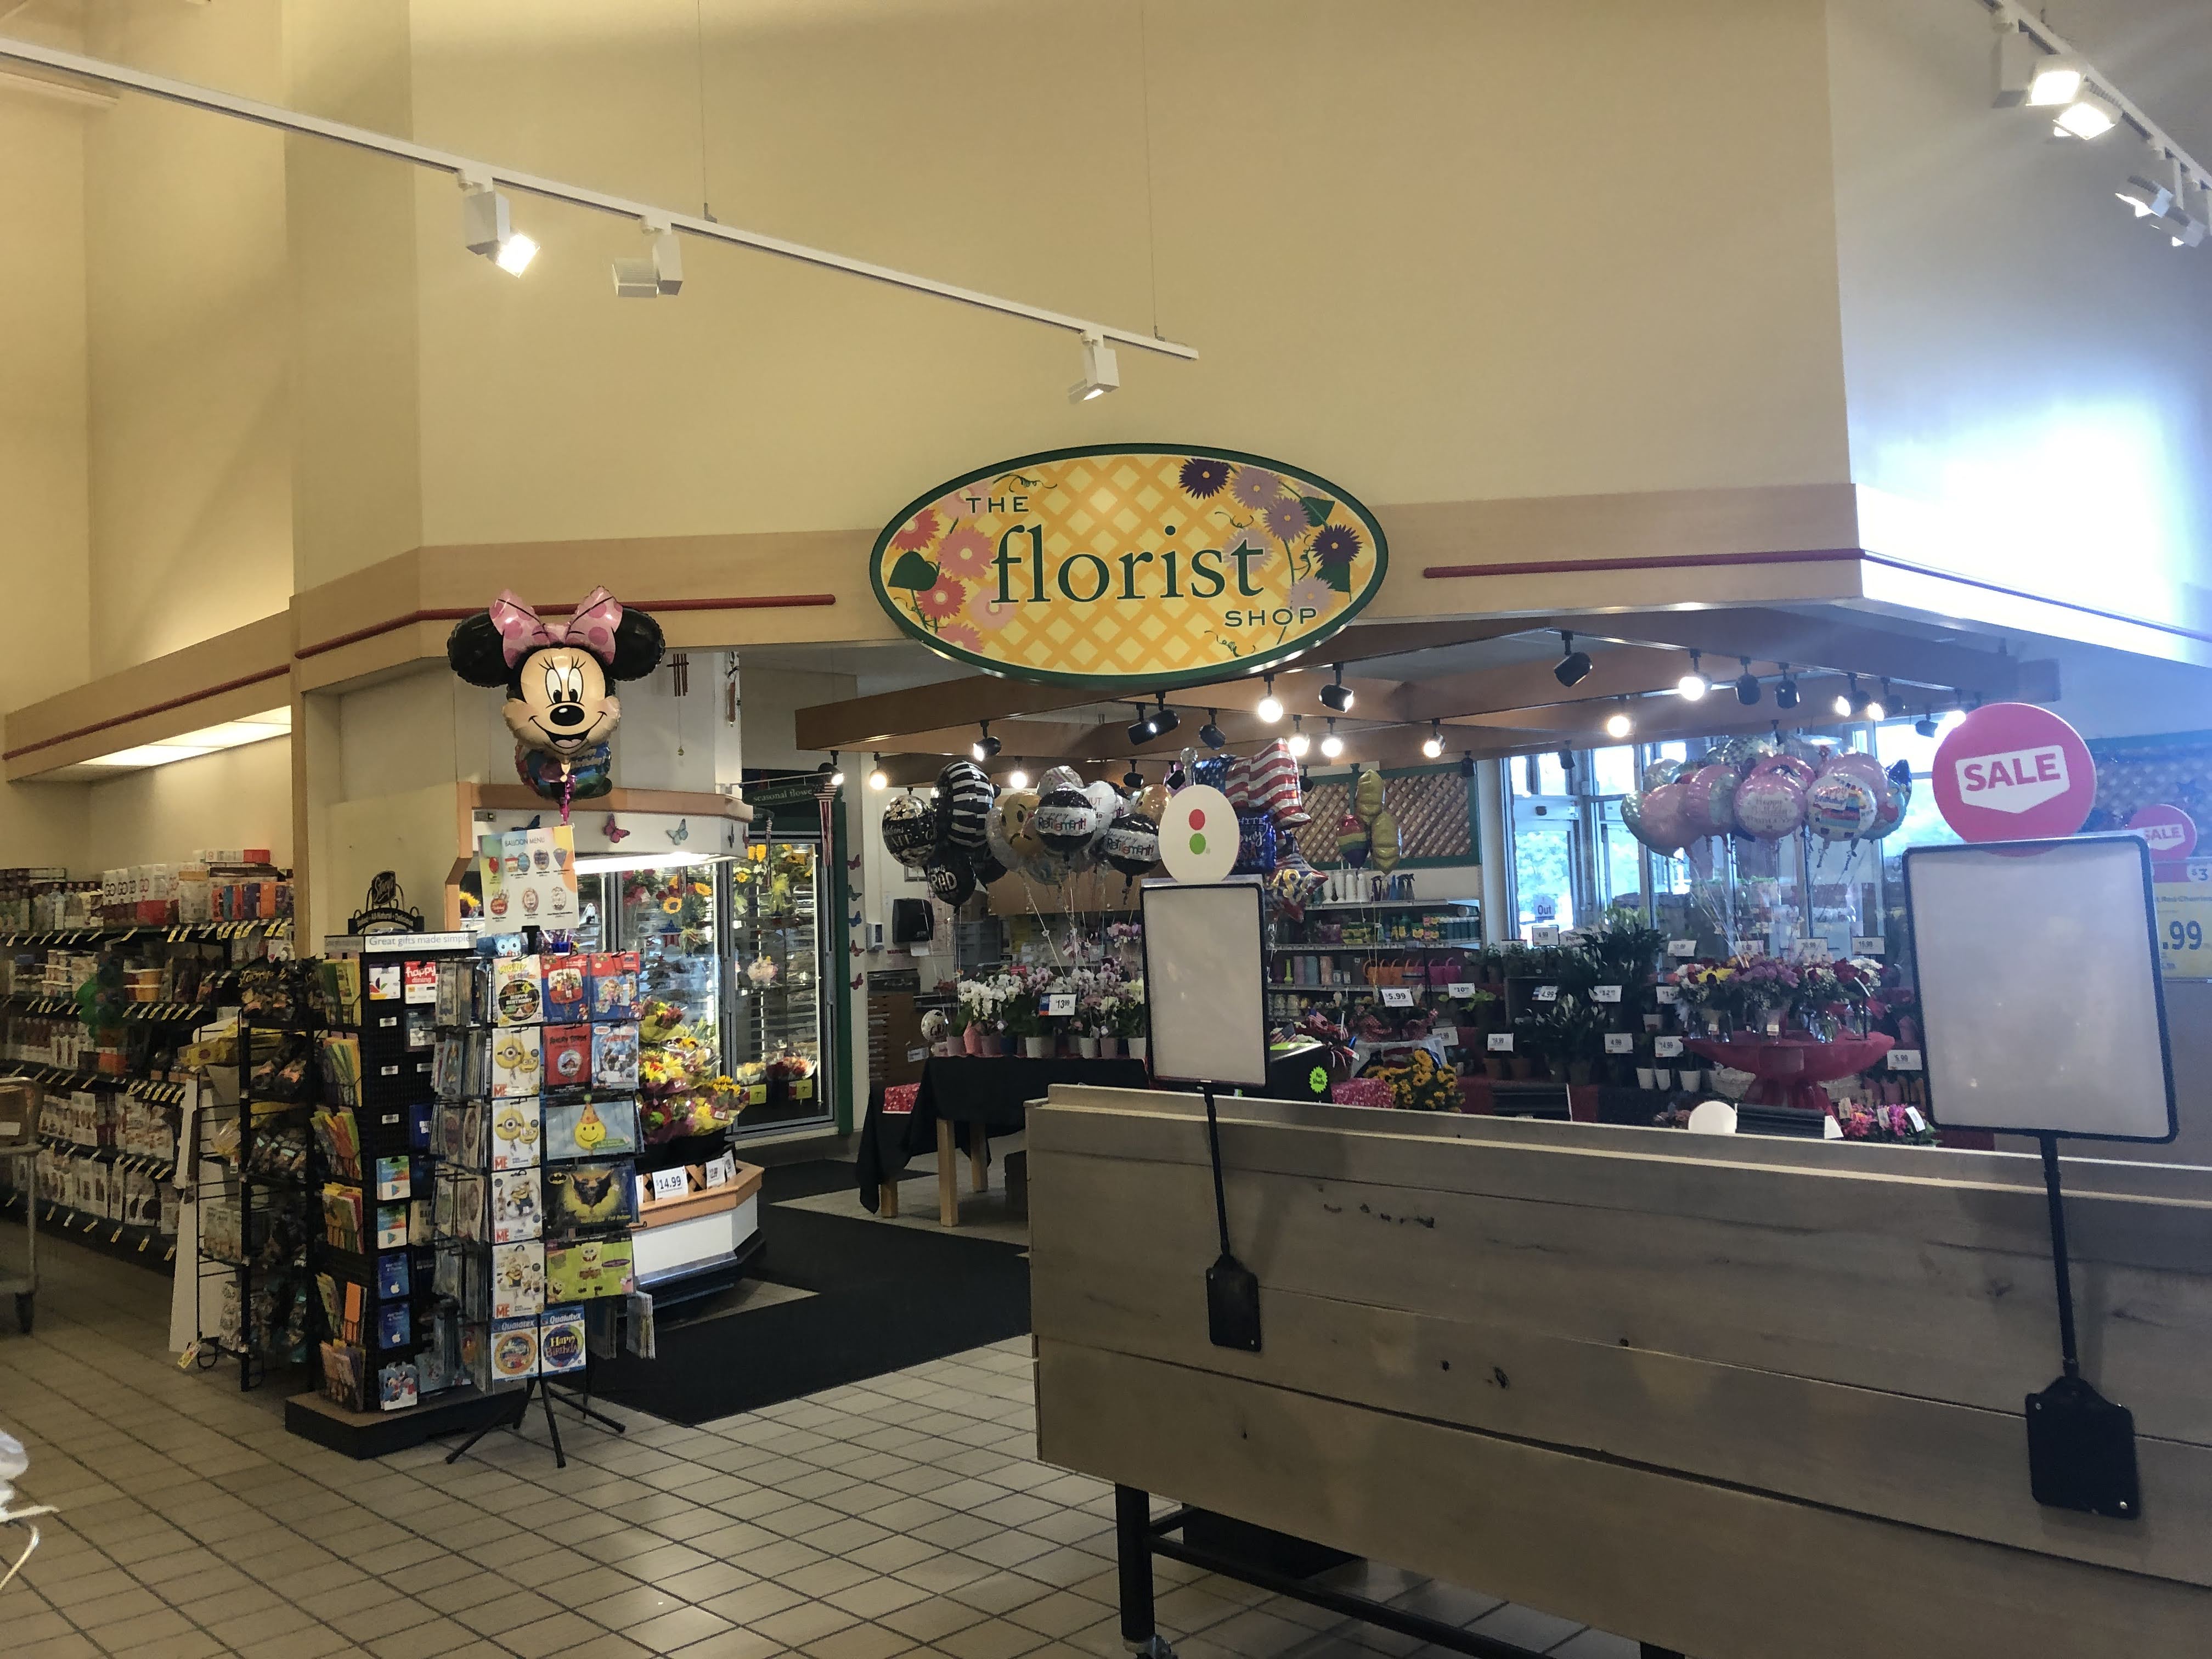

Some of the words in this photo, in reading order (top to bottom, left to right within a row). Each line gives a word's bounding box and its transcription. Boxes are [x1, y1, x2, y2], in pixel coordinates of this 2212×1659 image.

[966, 496, 1029, 513] THE
[990, 525, 1265, 603] florist
[1224, 607, 1317, 628] SHOP
[1964, 753, 2061, 791] SALE
[753, 790, 787, 802] seasonal
[789, 788, 812, 797] flowe
[1037, 816, 1087, 831] Retirement!
[2144, 826, 2182, 840] SALE
[504, 838, 528, 847] BALLOON
[930, 872, 957, 891] RAD
[1537, 905, 1552, 915] Out
[369, 936, 396, 946] Great
[398, 935, 415, 947] gifts
[417, 934, 440, 944] made
[443, 933, 471, 945] simple
[2163, 920, 2203, 950] .99
[406, 966, 436, 978] happy
[494, 1085, 507, 1097] ME
[495, 1156, 508, 1170] ME
[656, 1176, 681, 1189] $14.99
[496, 1229, 509, 1242] ME
[496, 1304, 510, 1317] ME
